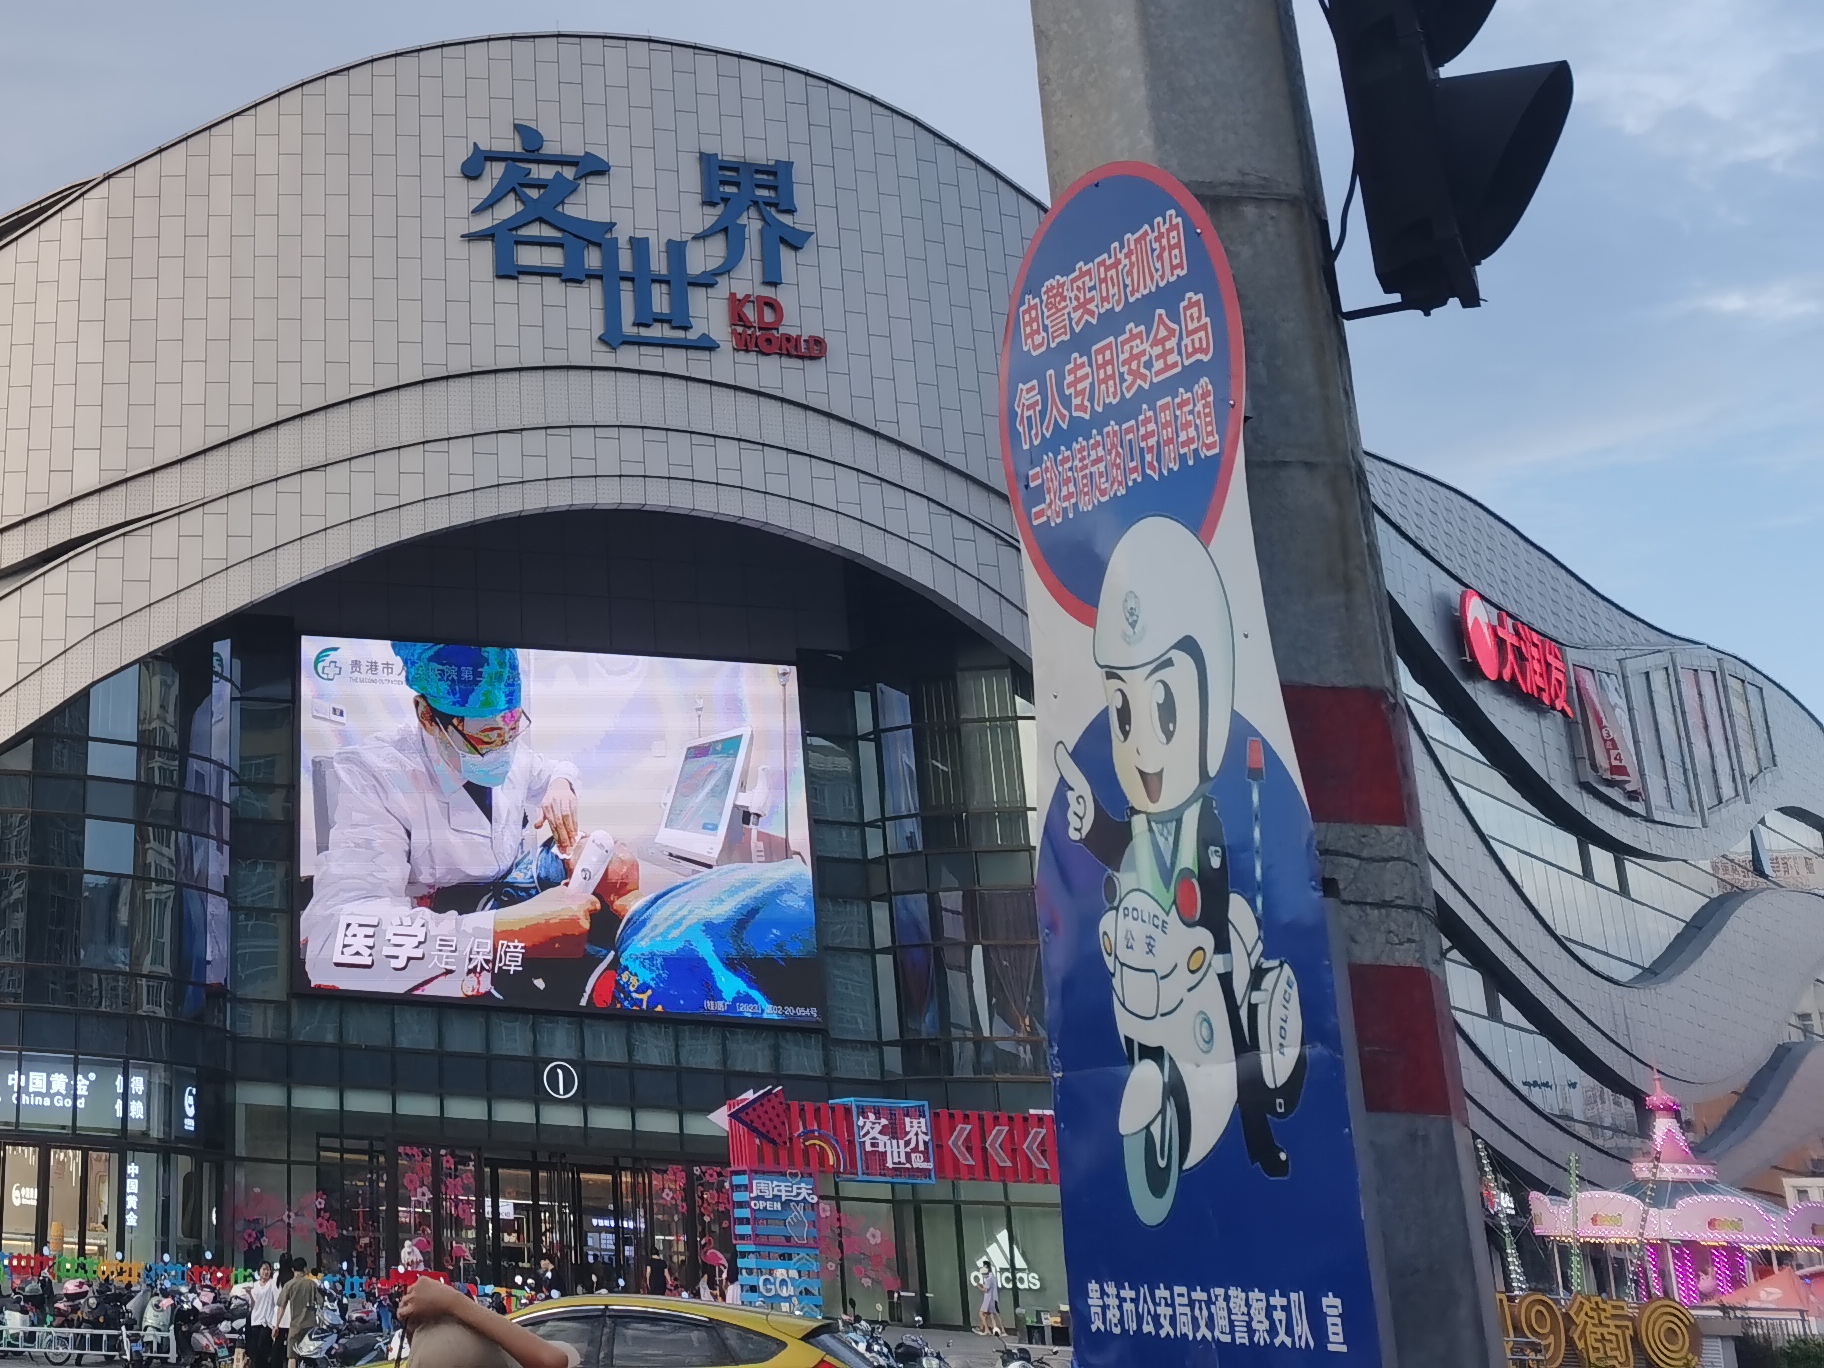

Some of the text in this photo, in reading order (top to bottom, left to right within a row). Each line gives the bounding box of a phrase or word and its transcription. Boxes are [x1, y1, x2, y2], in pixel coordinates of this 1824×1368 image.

[461, 122, 815, 349] 客世界
[728, 292, 784, 329] KD
[1018, 210, 1188, 357] 电警实时抓拍
[731, 327, 828, 359] WORLD
[1014, 292, 1213, 450] 行人专用安全岛
[1027, 377, 1220, 527] 二轮车请走路口专用车道
[1492, 610, 1574, 719] 大润发
[333, 915, 525, 975] 医学是保障
[1122, 906, 1169, 935] POLICE
[1124, 929, 1156, 957] 公安
[1278, 975, 1296, 1057] POLICE
[7, 1070, 90, 1096] 中国黄金
[11, 1093, 85, 1109] China God
[858, 1112, 931, 1168] 客世界
[125, 1162, 139, 1227] 中国黄金
[750, 1180, 818, 1203] 周年庆
[751, 1200, 781, 1211] OPEN
[970, 1266, 1040, 1289] aidas
[1087, 1279, 1347, 1353] 贵港市公安局交通警察支队 宣
